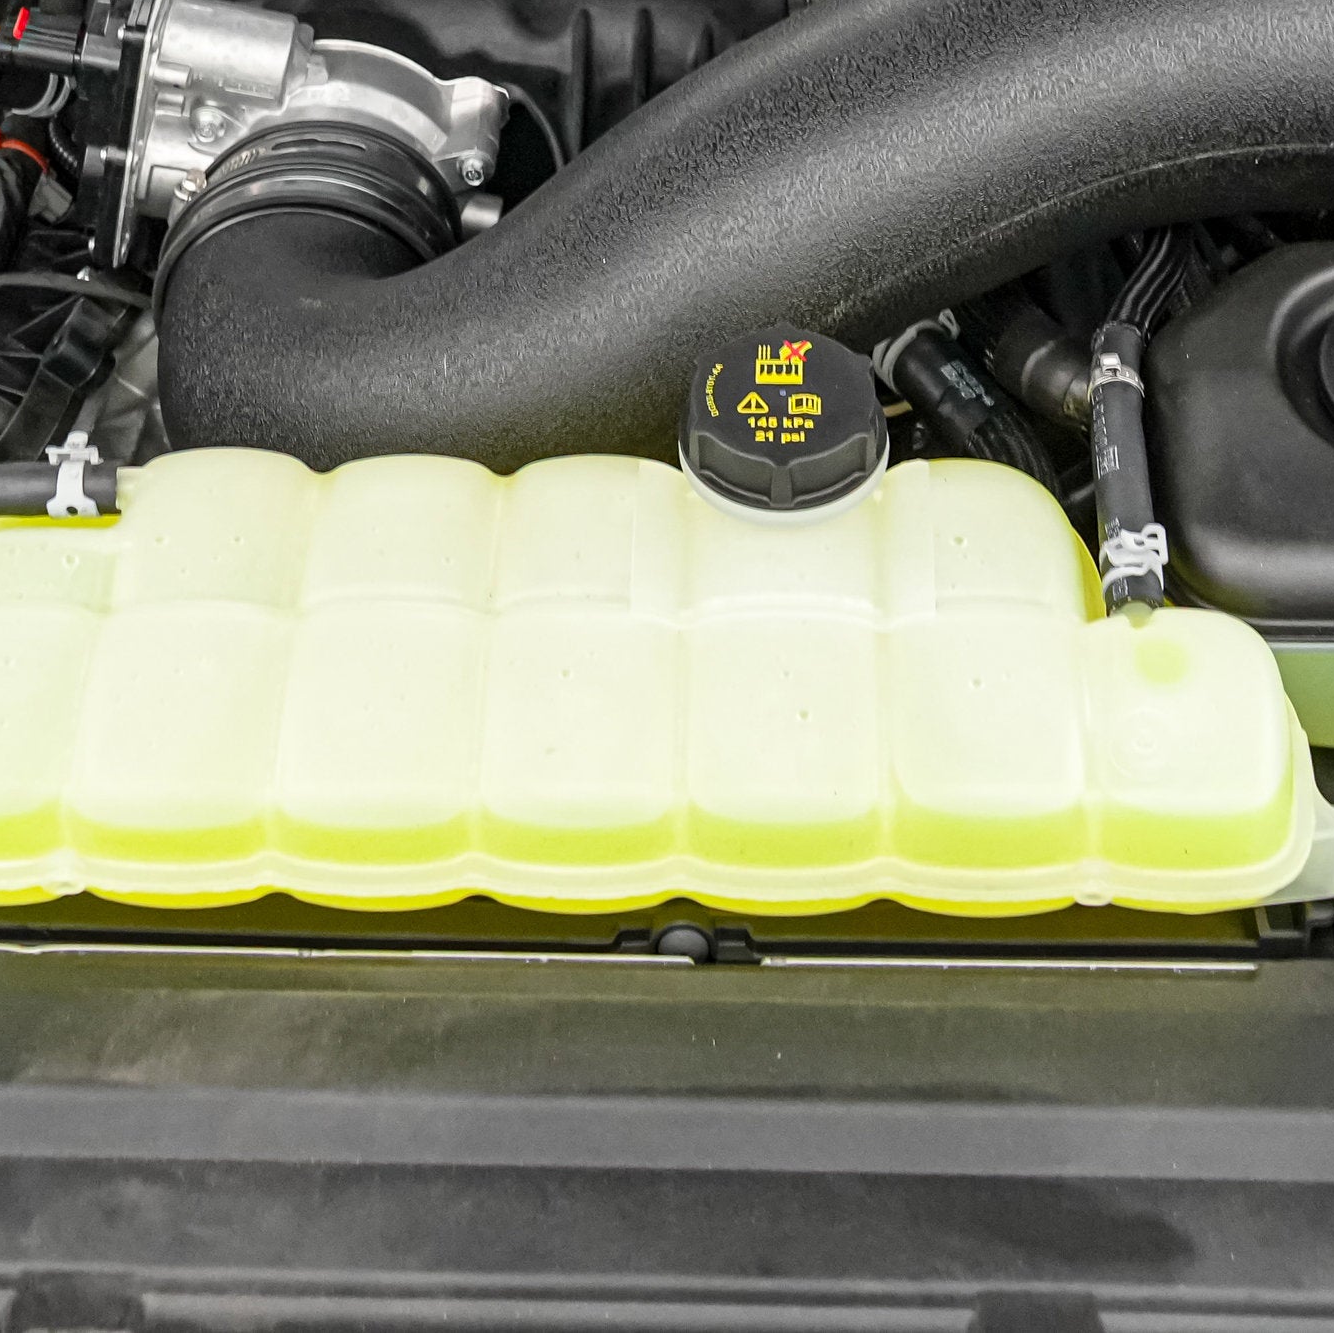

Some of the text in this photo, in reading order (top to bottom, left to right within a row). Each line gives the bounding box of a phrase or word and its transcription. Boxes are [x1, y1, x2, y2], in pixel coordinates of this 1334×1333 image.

[747, 416, 815, 429] 145 kPa
[754, 429, 806, 445] 21 psi
